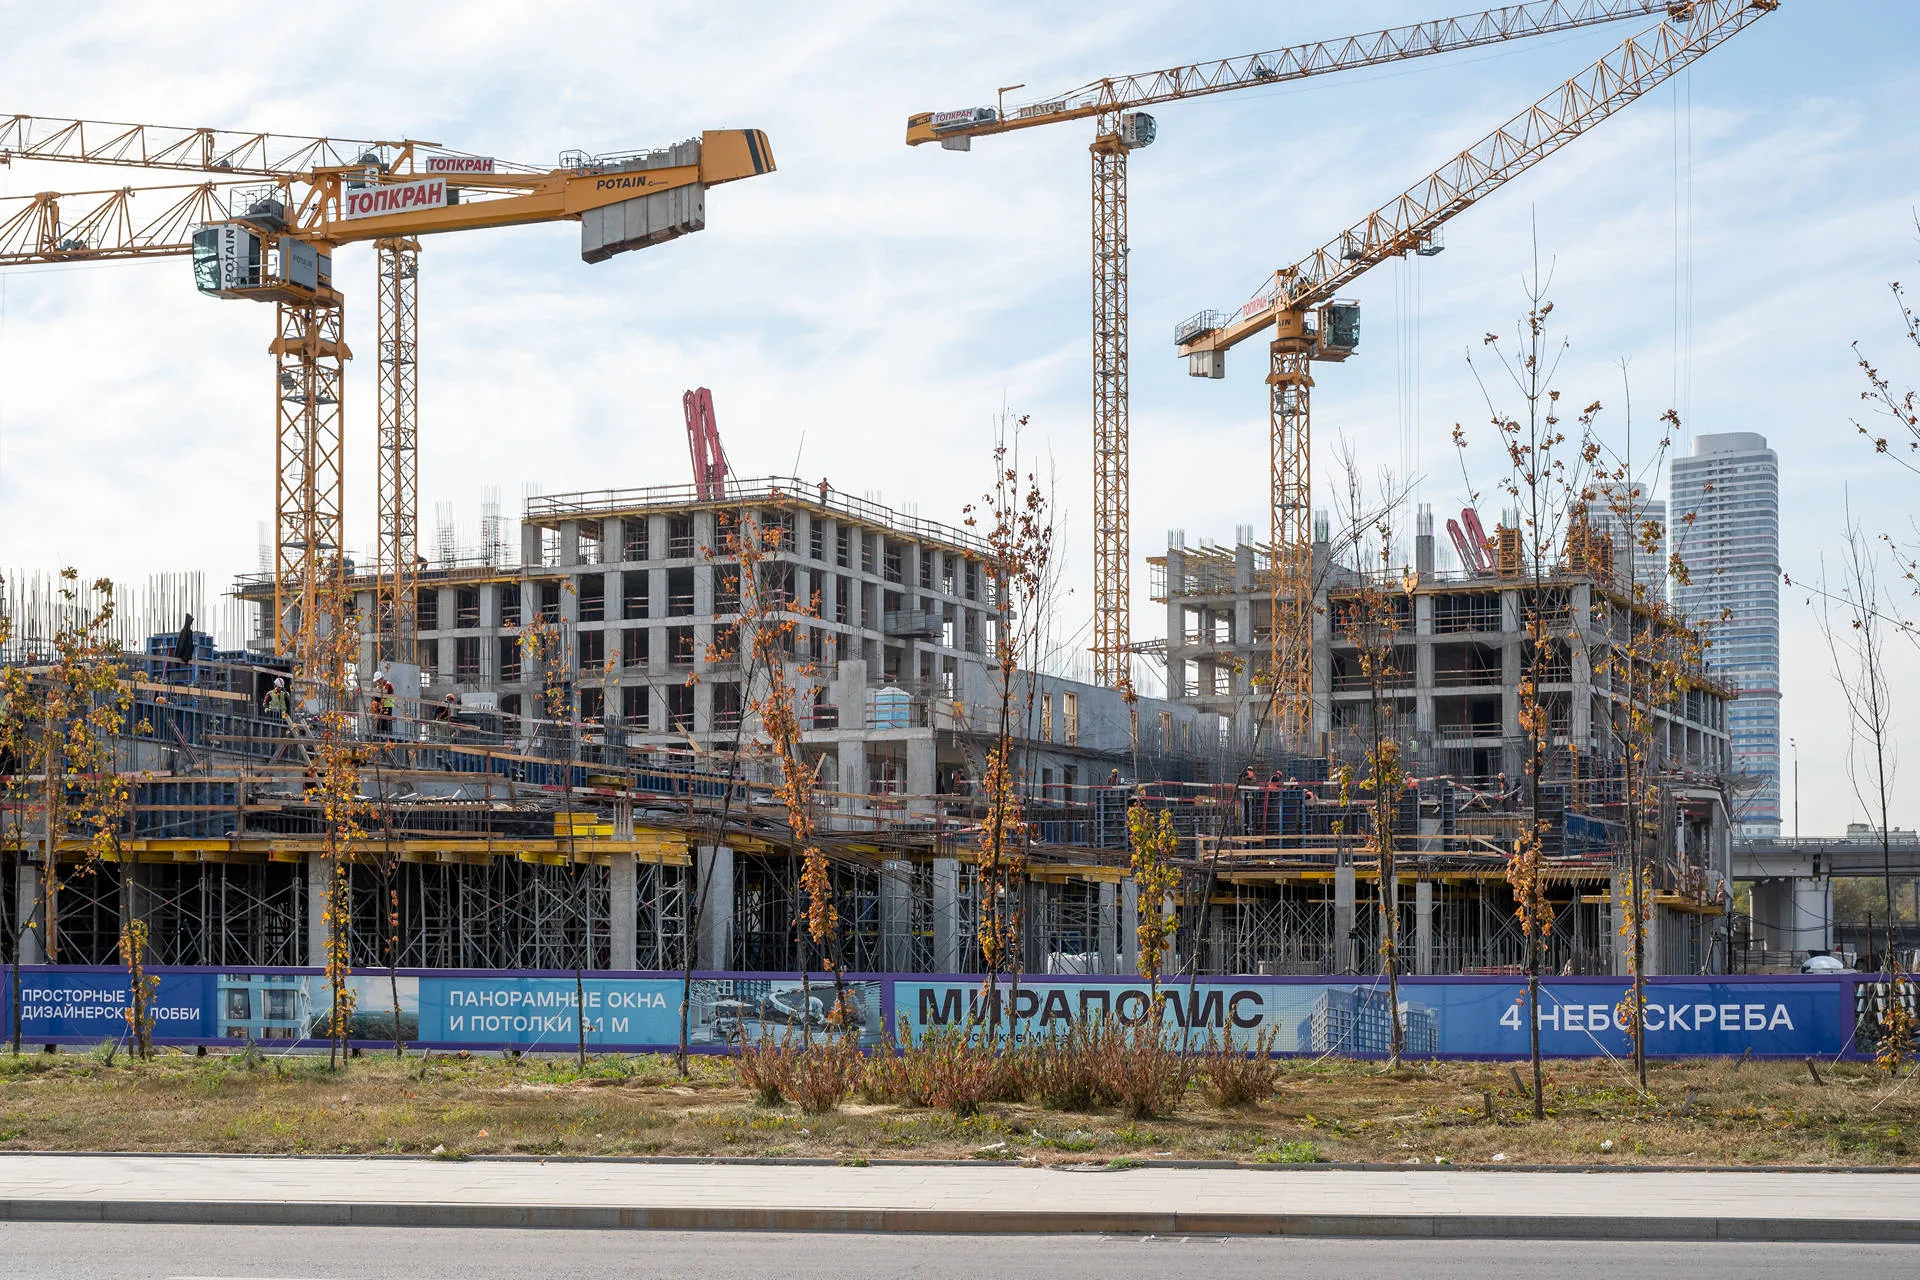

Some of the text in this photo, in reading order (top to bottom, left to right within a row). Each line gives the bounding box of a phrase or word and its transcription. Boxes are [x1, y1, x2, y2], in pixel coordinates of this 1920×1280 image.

[935, 109, 973, 122] ТОПКРАН
[429, 158, 493, 172] ТОПКРАН
[597, 175, 647, 190] POTAIN
[348, 182, 443, 214] ТОПКРАН
[225, 229, 235, 282] POTAIN
[22, 989, 125, 1003] ПРОСТОРНЫЕ
[450, 991, 667, 1008] ПАНОРАМНЫЕ ОКНА
[21, 1003, 144, 1020] ДИЗАЙНЕРСК
[919, 988, 1264, 1028] МИРАПОЛИС
[450, 1015, 464, 1032] И
[471, 1015, 572, 1032] ПОТОЛКИ
[611, 1017, 629, 1033] М
[1500, 1004, 1522, 1031] 4
